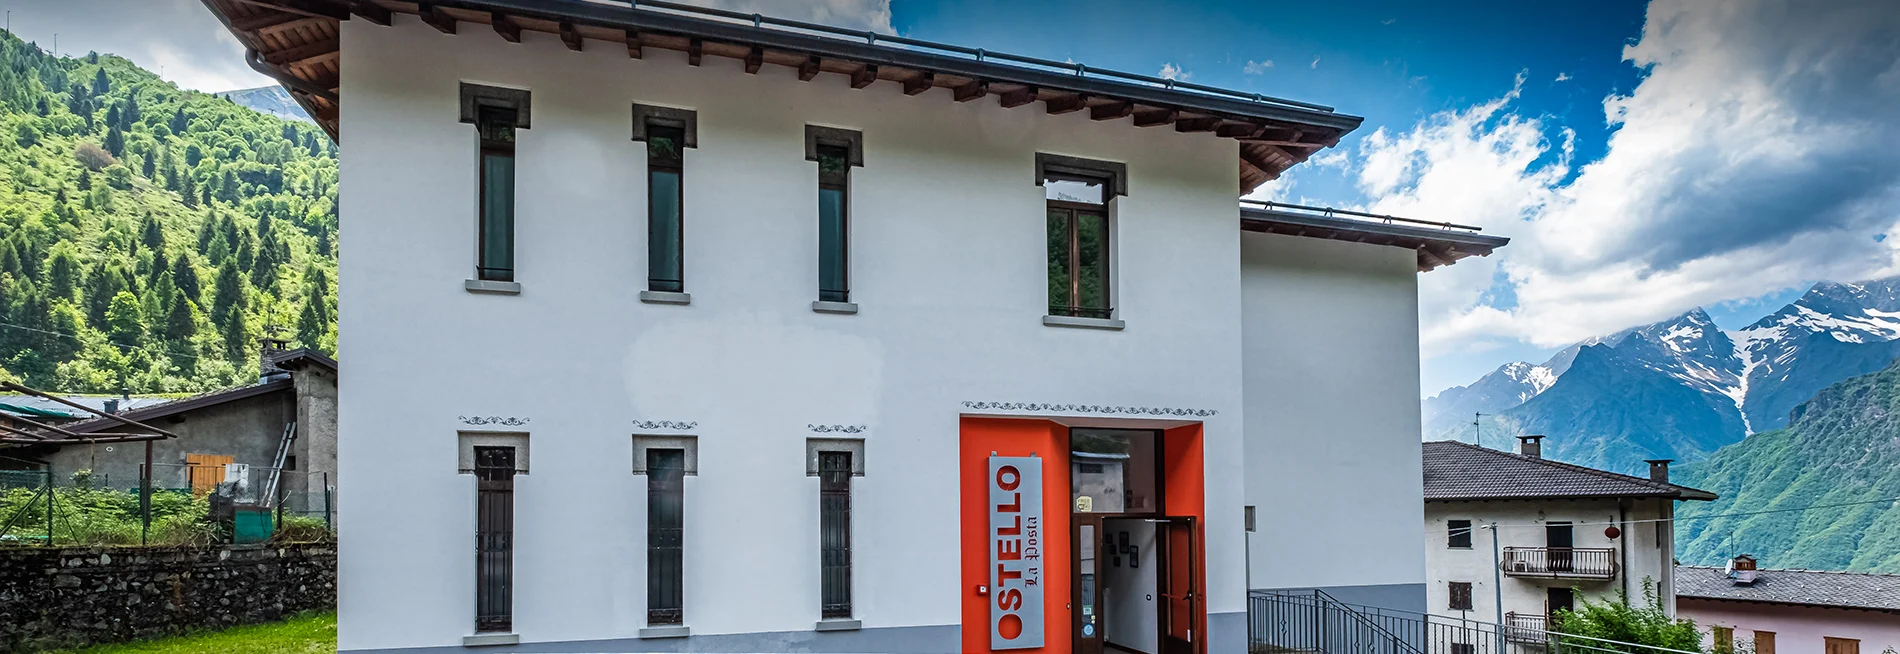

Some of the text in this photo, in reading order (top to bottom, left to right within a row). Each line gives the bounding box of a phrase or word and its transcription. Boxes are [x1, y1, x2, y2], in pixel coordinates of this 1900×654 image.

[996, 464, 1023, 640] OSTELLO
[1024, 516, 1039, 588] La Posta
